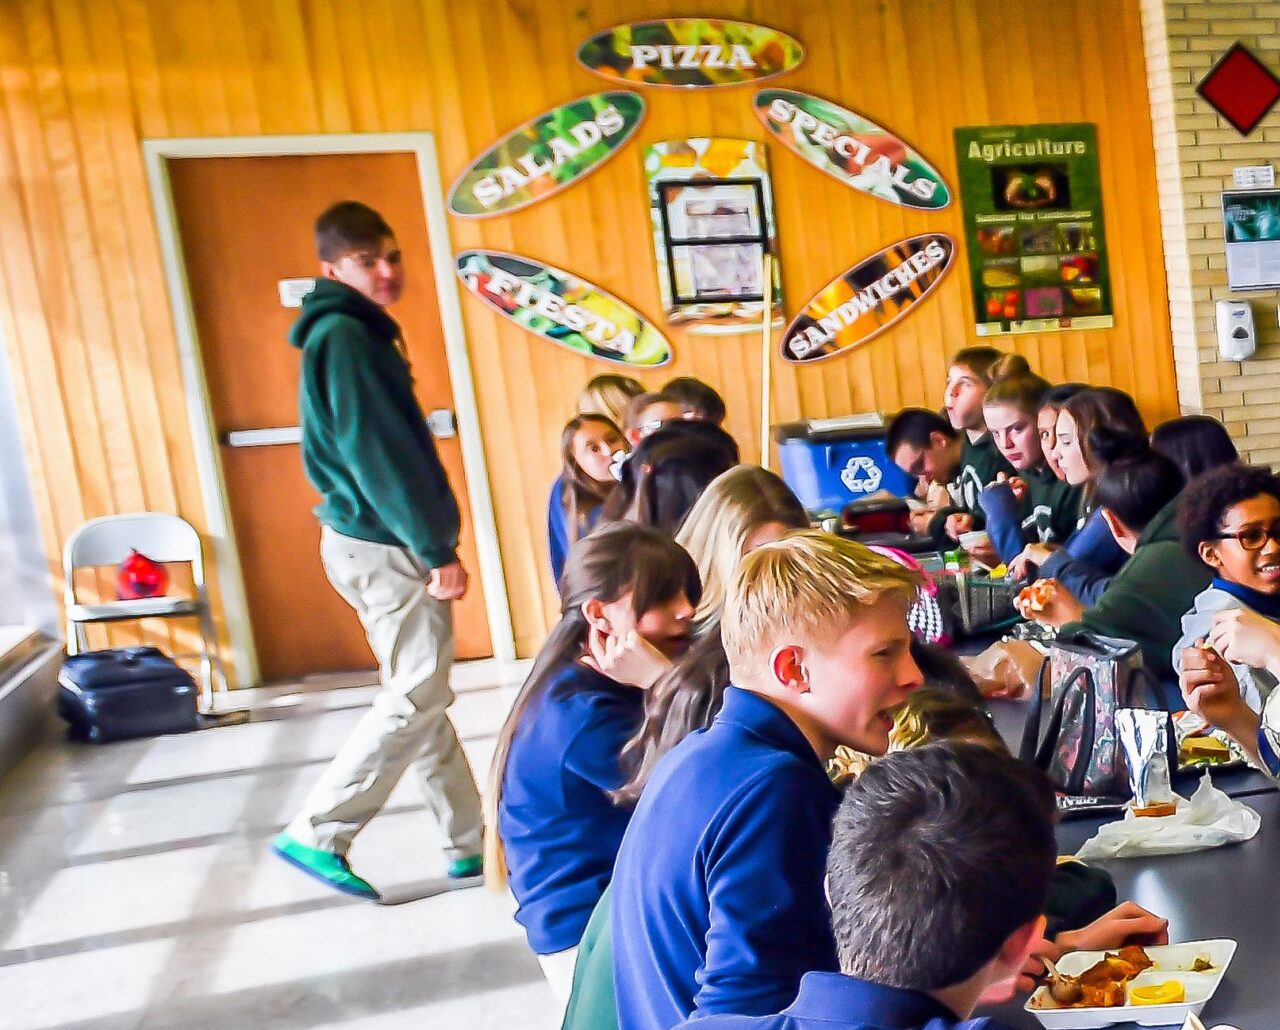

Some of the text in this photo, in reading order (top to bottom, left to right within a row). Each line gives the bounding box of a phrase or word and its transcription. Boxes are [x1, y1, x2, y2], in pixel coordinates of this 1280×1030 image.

[630, 44, 756, 69] PIZZA
[472, 104, 625, 209] SALADS
[768, 98, 937, 200] SPECIALS
[967, 139, 1086, 162] Agriculture
[486, 265, 637, 356] FIESTA
[788, 240, 945, 360] SANDWICHES
